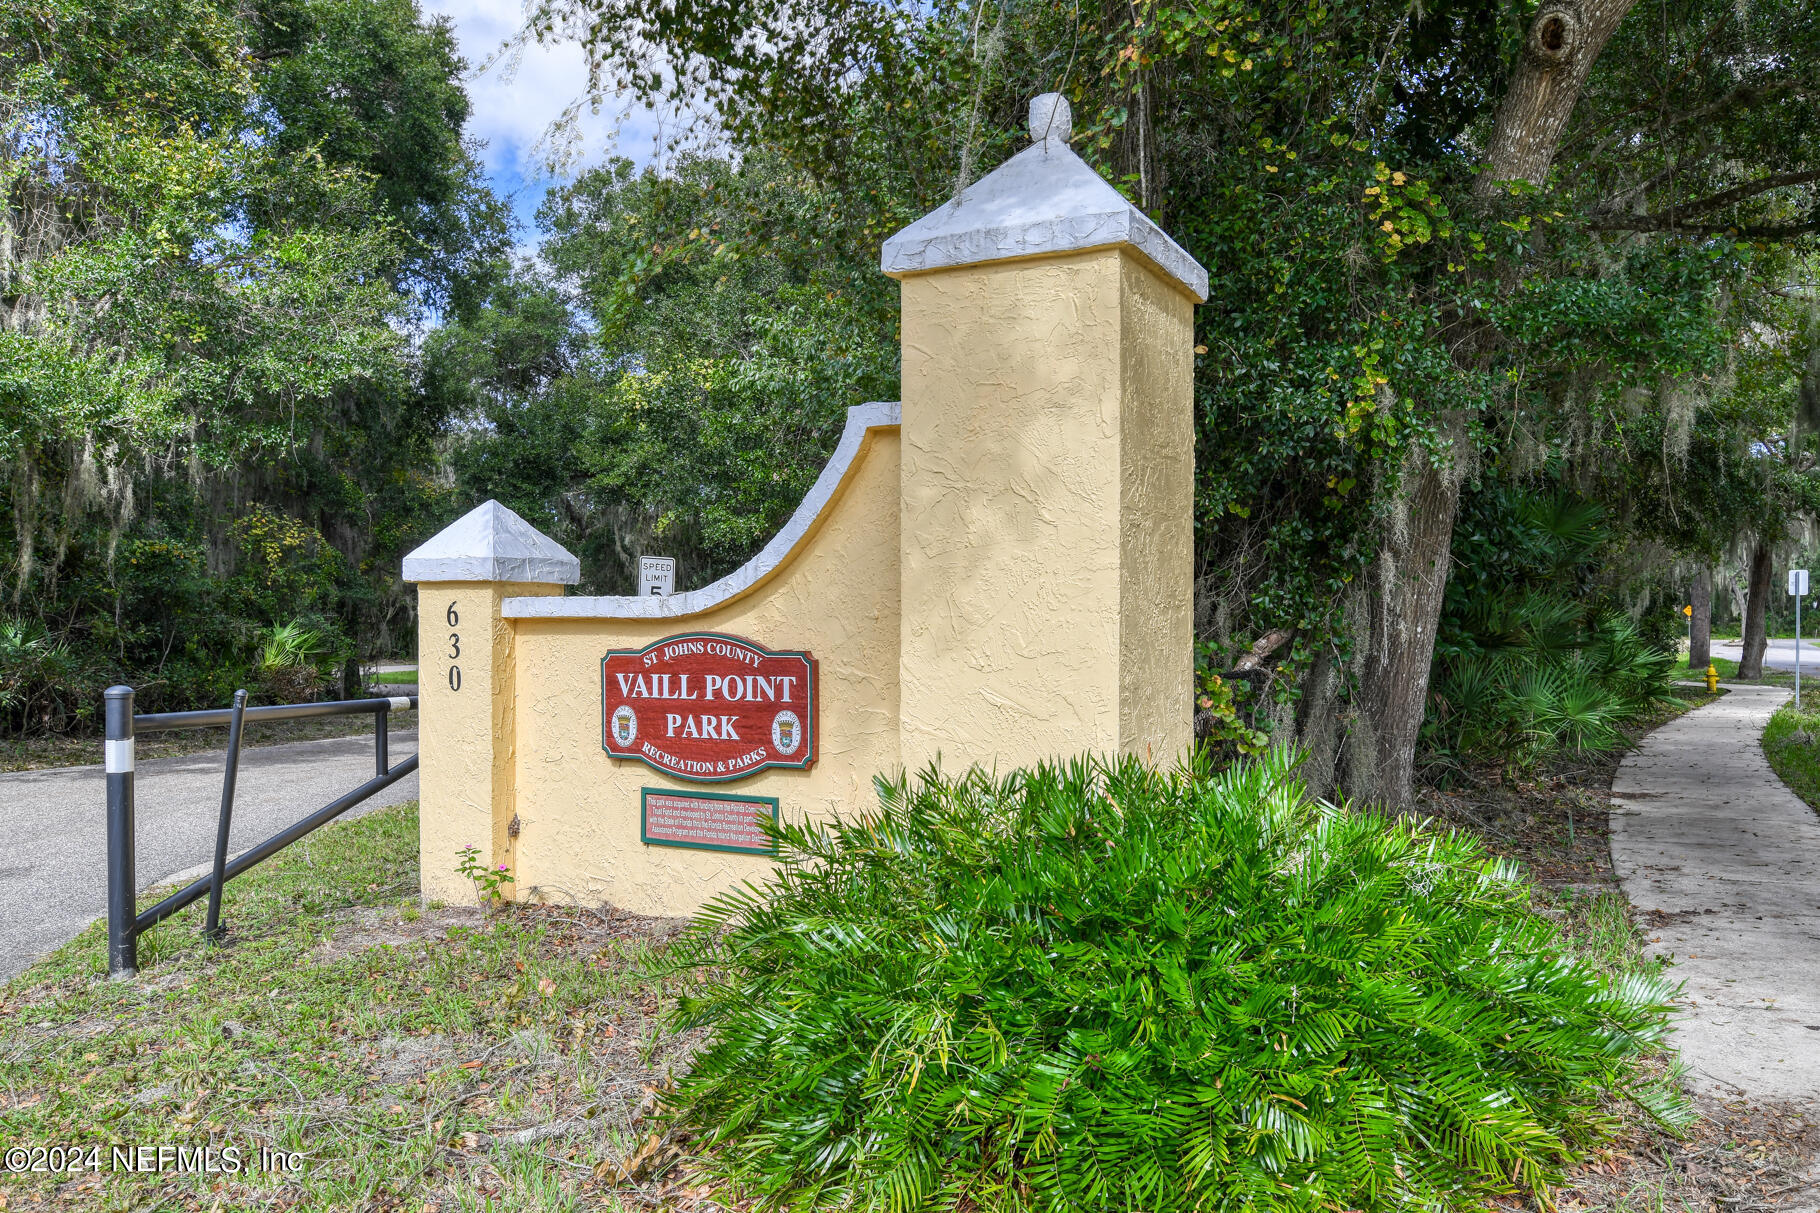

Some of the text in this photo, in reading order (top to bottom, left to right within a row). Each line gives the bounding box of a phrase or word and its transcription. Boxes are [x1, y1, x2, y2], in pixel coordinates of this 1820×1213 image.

[643, 563, 671, 571] SPEED
[645, 574, 668, 582] LIMIT
[446, 601, 461, 692] 630
[643, 641, 763, 668] ST JOHNS COUNTY
[615, 673, 797, 702] VAILL POINT
[666, 713, 740, 740] PARK
[641, 741, 767, 773] RECREATION & PARKS
